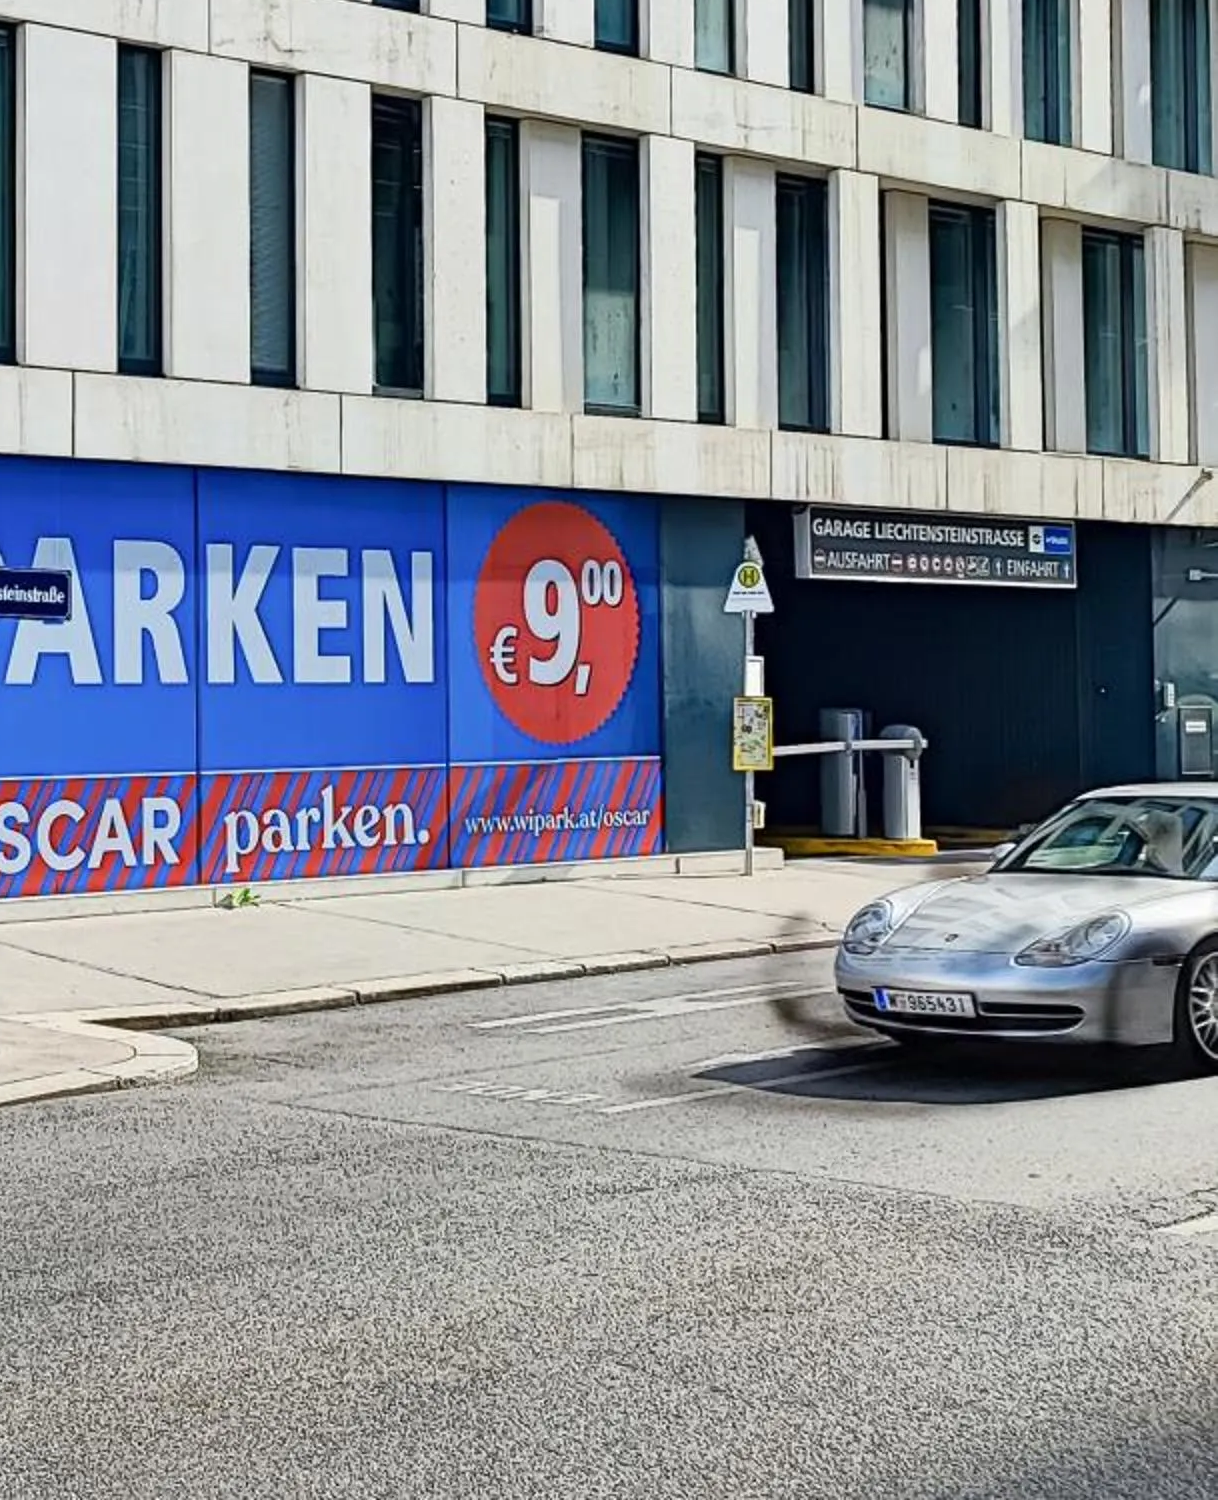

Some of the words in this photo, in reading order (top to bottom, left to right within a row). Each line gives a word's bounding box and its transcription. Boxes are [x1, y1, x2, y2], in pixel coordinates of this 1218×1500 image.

[812, 517, 872, 539] GARAGE
[874, 522, 1026, 547] LIECHTENSTEINSTRASSE
[827, 551, 891, 574] AUSFAHRT
[1006, 560, 1060, 578] EINFAHRT
[224, 784, 431, 873] parken.
[465, 803, 651, 837] www.wipark.at/oscar
